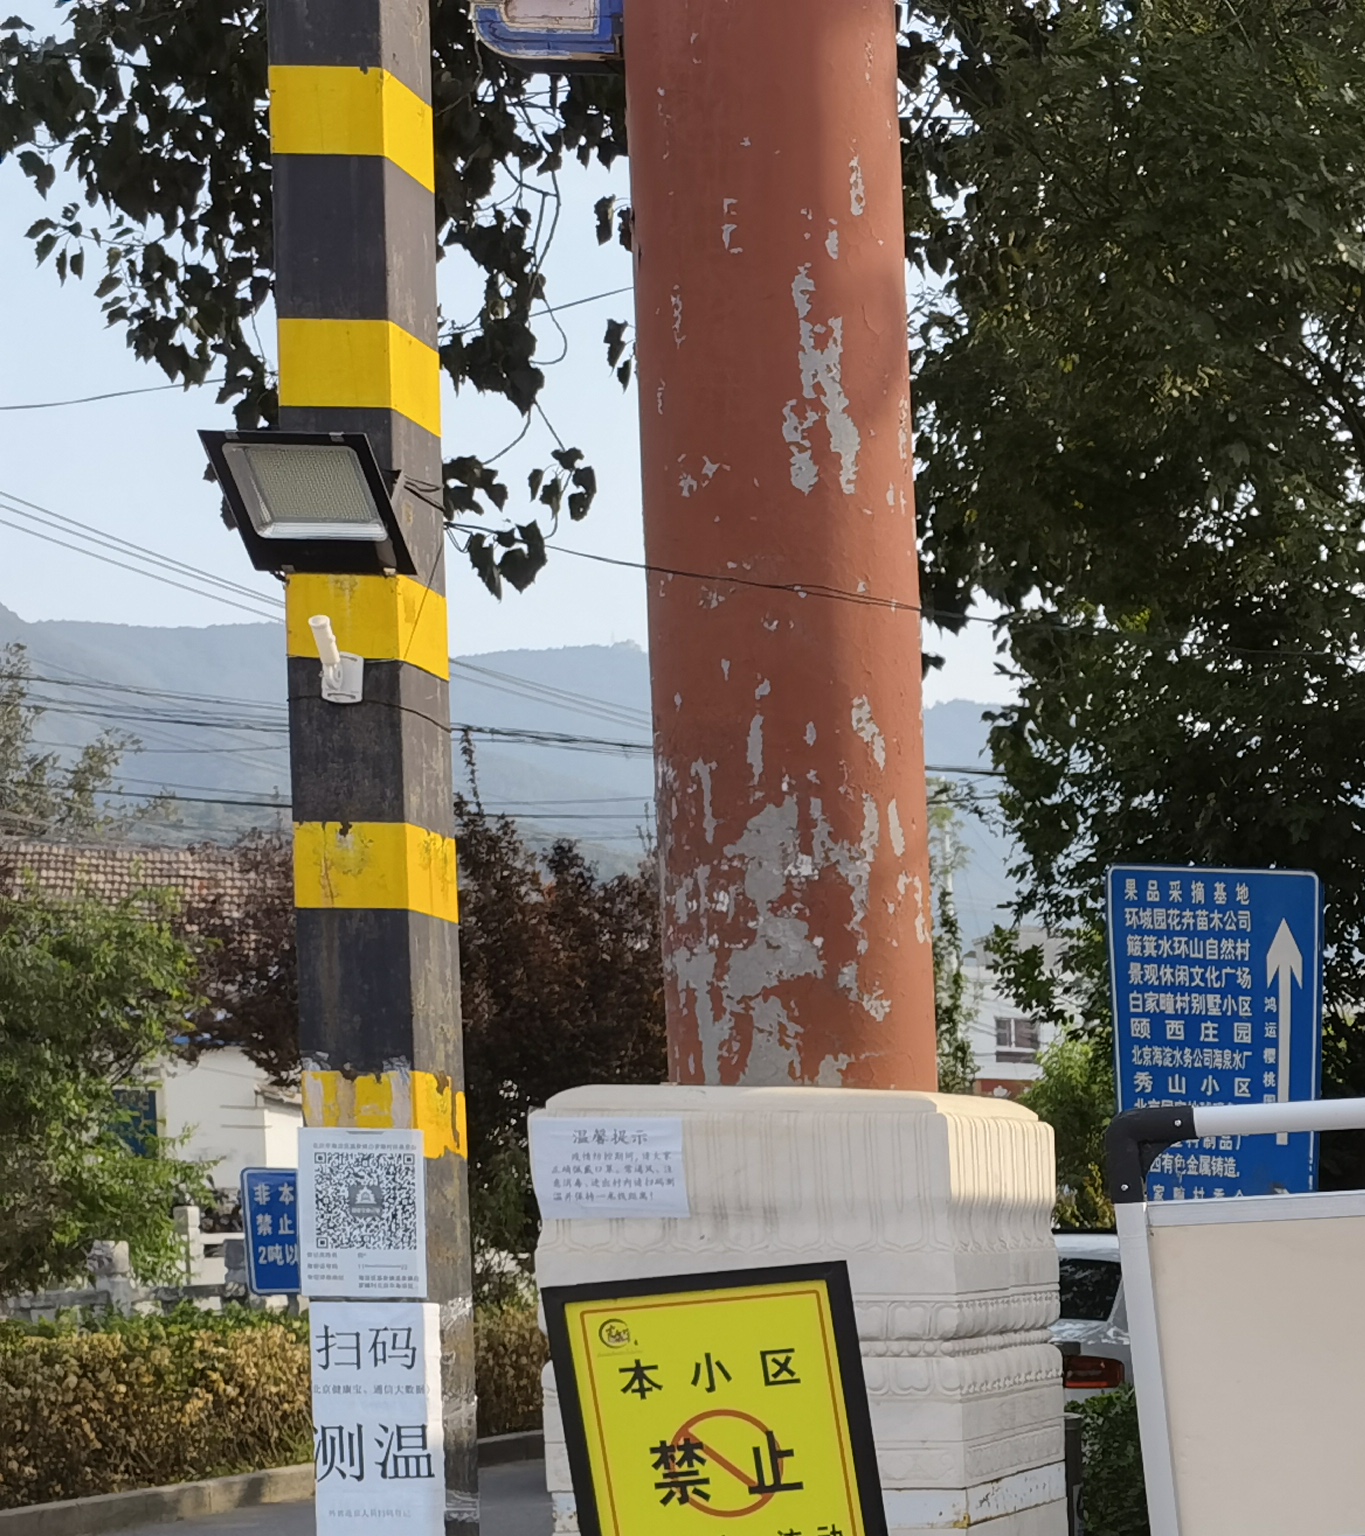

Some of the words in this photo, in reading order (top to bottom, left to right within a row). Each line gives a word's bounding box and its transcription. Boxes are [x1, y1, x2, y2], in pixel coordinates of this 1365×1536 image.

[1124, 879, 1251, 905] 果品采摘基地
[1124, 907, 1252, 933] 环城园花卉苗木公司
[1128, 963, 1253, 990] 景观休闲文化广场
[1128, 991, 1254, 1018] 白家疃村别墅小区
[1130, 1017, 1253, 1045] 颐西庄园
[1131, 1047, 1253, 1072] 北京海淀水务公司海泉水厂
[1134, 1071, 1252, 1098] 秀山小区
[572, 1128, 650, 1146] 温馨提示
[256, 1213, 295, 1237] 禁止
[315, 1324, 417, 1372] 扫码
[619, 1347, 802, 1401] 本小区
[313, 1422, 436, 1483] 测温
[649, 1429, 805, 1508] 禁止
